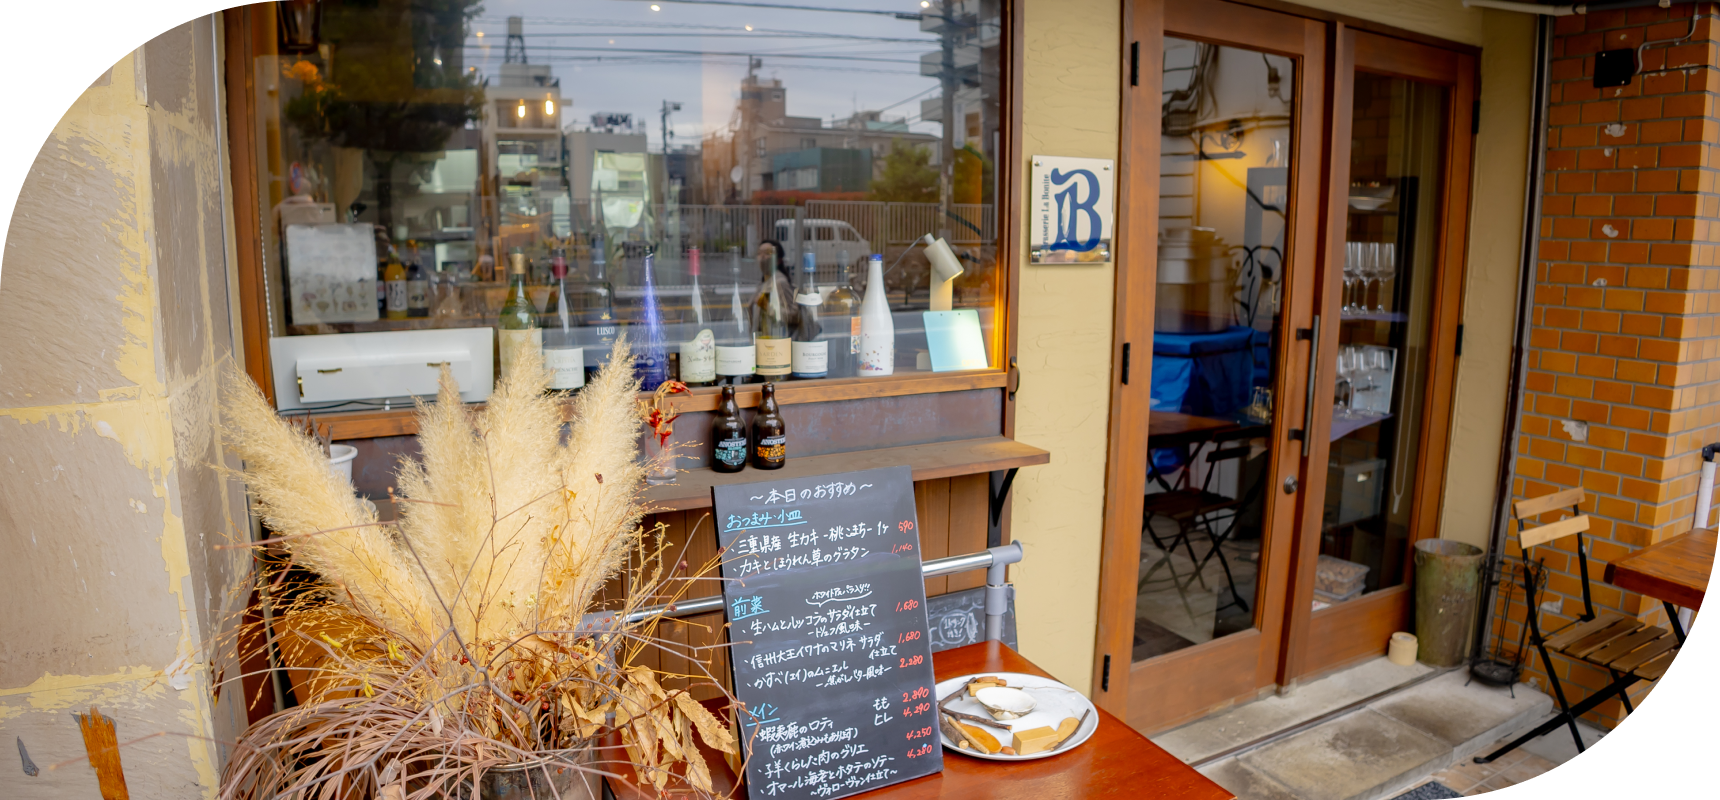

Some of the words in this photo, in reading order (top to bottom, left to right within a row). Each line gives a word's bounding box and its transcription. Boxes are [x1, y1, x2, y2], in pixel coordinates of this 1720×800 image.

[1050, 168, 1102, 252] B
[596, 326, 615, 336] LUSCO
[737, 534, 782, 555] 三重県産
[787, 528, 819, 548] 生カキ
[898, 520, 914, 534] 590
[731, 595, 765, 618] 前菜
[750, 603, 878, 637] 生ハムとルッコラのサラダ仕立て
[750, 638, 857, 670] 信州大王イワナのマリネ
[858, 631, 885, 649] サラダ
[868, 645, 898, 660] 仕立て
[749, 702, 779, 721] メイン
[873, 696, 891, 711] もも
[873, 712, 894, 726] ヒレ
